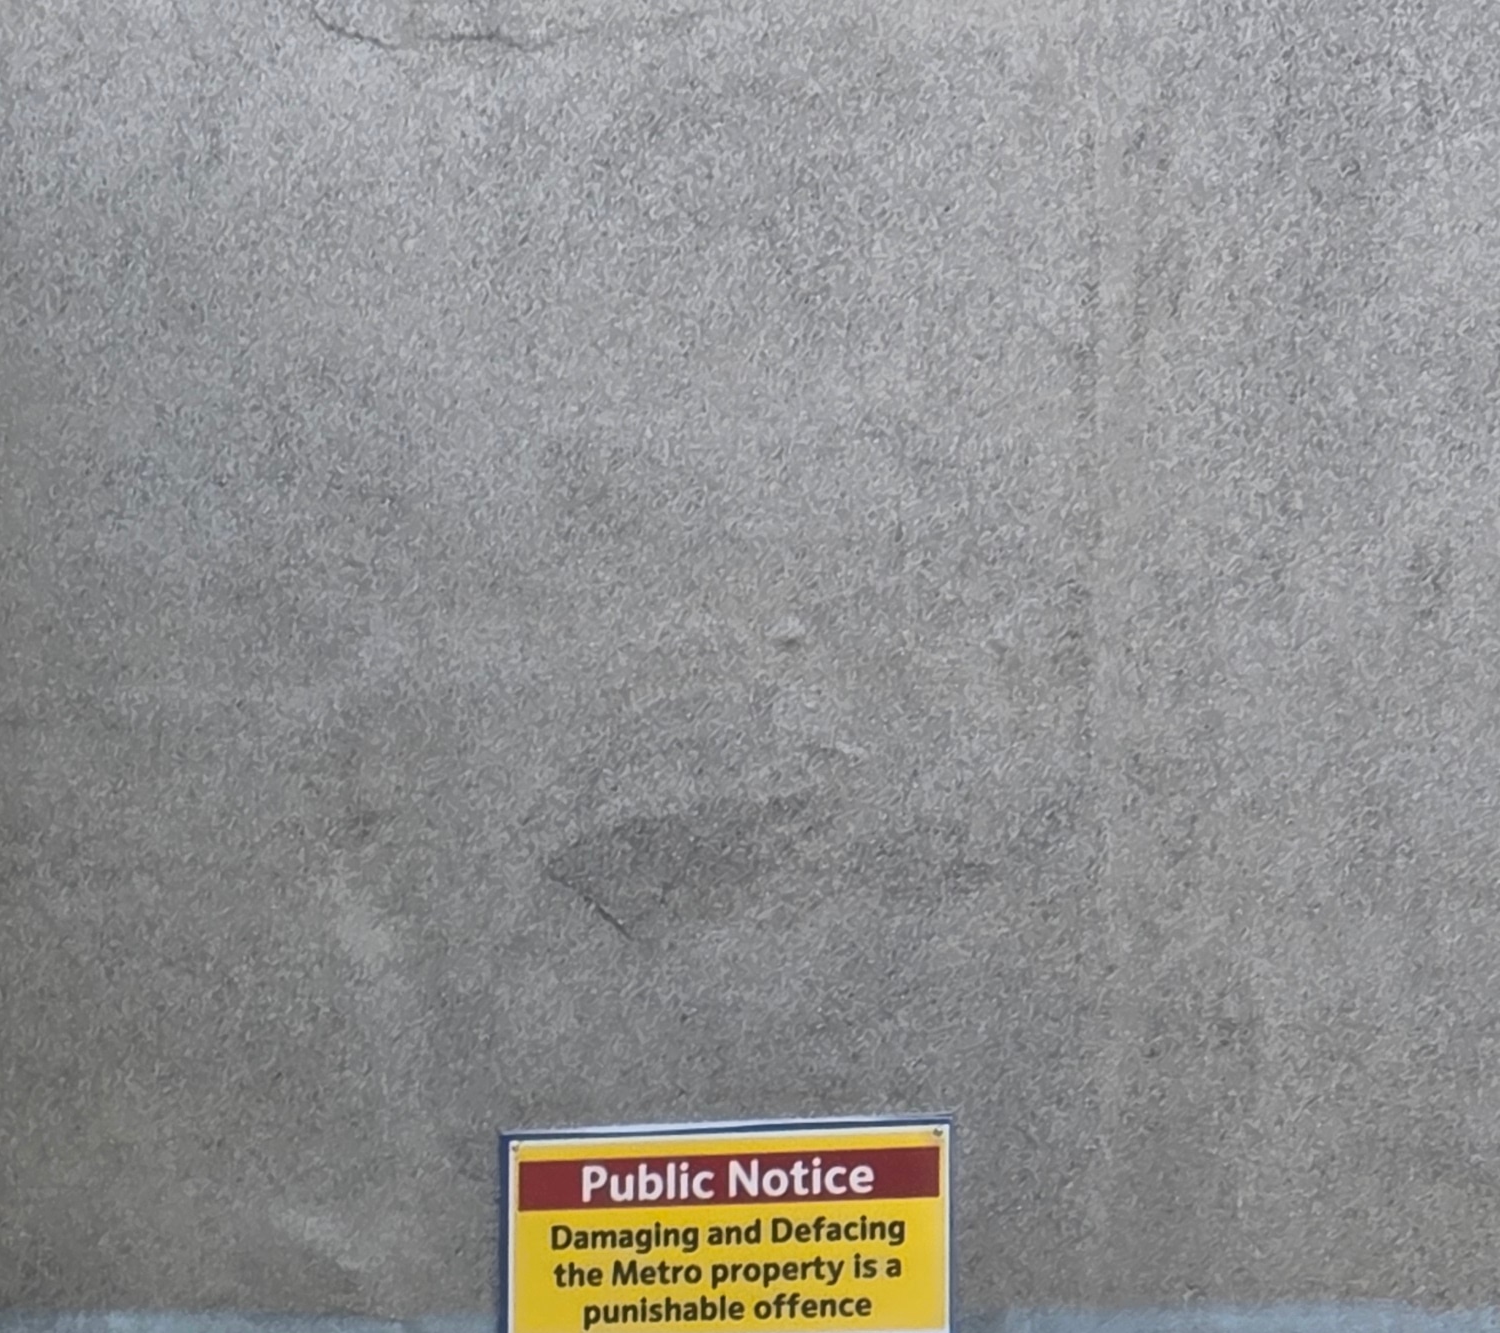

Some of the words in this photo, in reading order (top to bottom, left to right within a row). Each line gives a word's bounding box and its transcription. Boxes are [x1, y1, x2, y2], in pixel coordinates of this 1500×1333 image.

[581, 1162, 715, 1203] Public
[728, 1157, 875, 1198] Notice
[551, 1222, 699, 1254] Damaging
[707, 1219, 761, 1246] and
[771, 1215, 905, 1246] Defacing
[554, 1262, 603, 1288] the
[612, 1260, 701, 1286] Metro
[711, 1254, 844, 1288] property
[854, 1253, 877, 1279] is
[886, 1258, 901, 1278] a
[583, 1295, 744, 1330] punishable
[753, 1293, 871, 1319] offence
